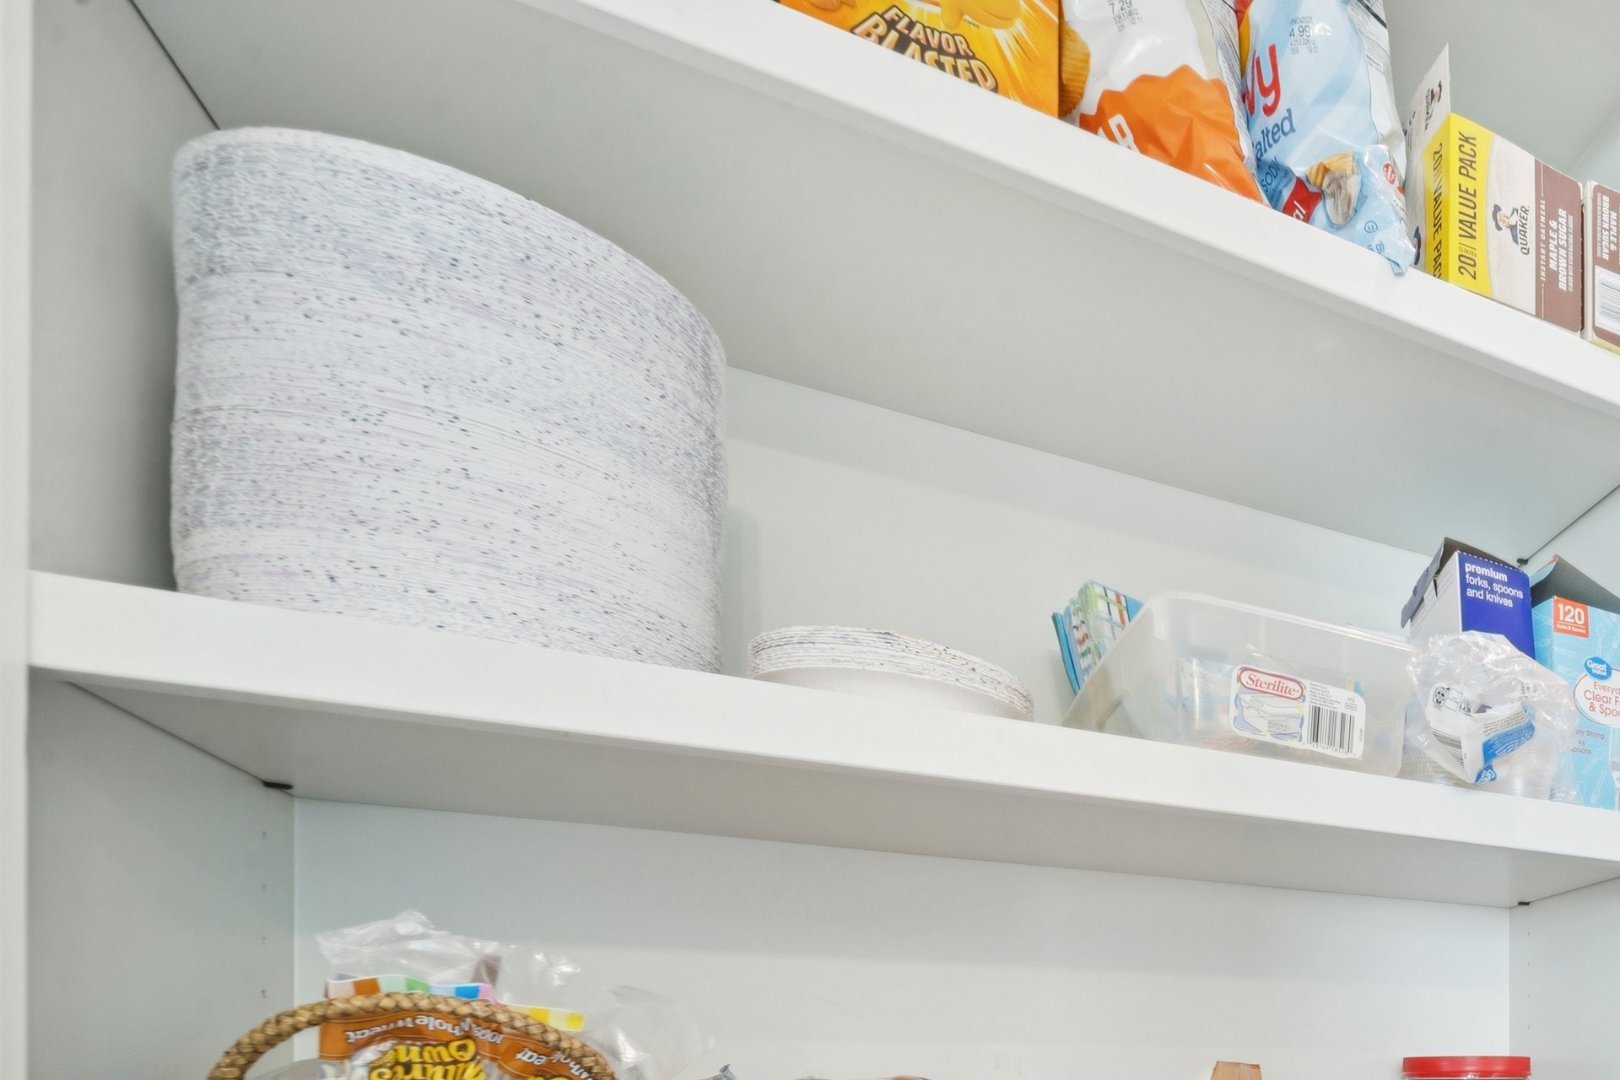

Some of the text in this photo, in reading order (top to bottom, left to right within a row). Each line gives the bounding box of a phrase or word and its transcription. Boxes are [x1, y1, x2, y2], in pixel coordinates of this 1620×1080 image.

[886, 6, 974, 58] FLAVOR
[1458, 132, 1478, 280] 20 VALUE PACK
[1520, 205, 1531, 256] QUAKER
[1557, 208, 1567, 248] SUGAR
[1601, 195, 1609, 261] BROWN SUGAR
[1609, 210, 1617, 243] MAPLE
[1549, 231, 1558, 271] MAPLE
[1558, 249, 1567, 291] BROWN
[1465, 561, 1508, 582] premium
[1465, 573, 1524, 600] forks, spoons
[1466, 588, 1514, 608] and knives
[1558, 603, 1585, 625] 120
[1587, 659, 1607, 672] Great
[1246, 673, 1297, 698] Sterilite
[1583, 689, 1612, 707] Clear
[1588, 702, 1597, 713] &
